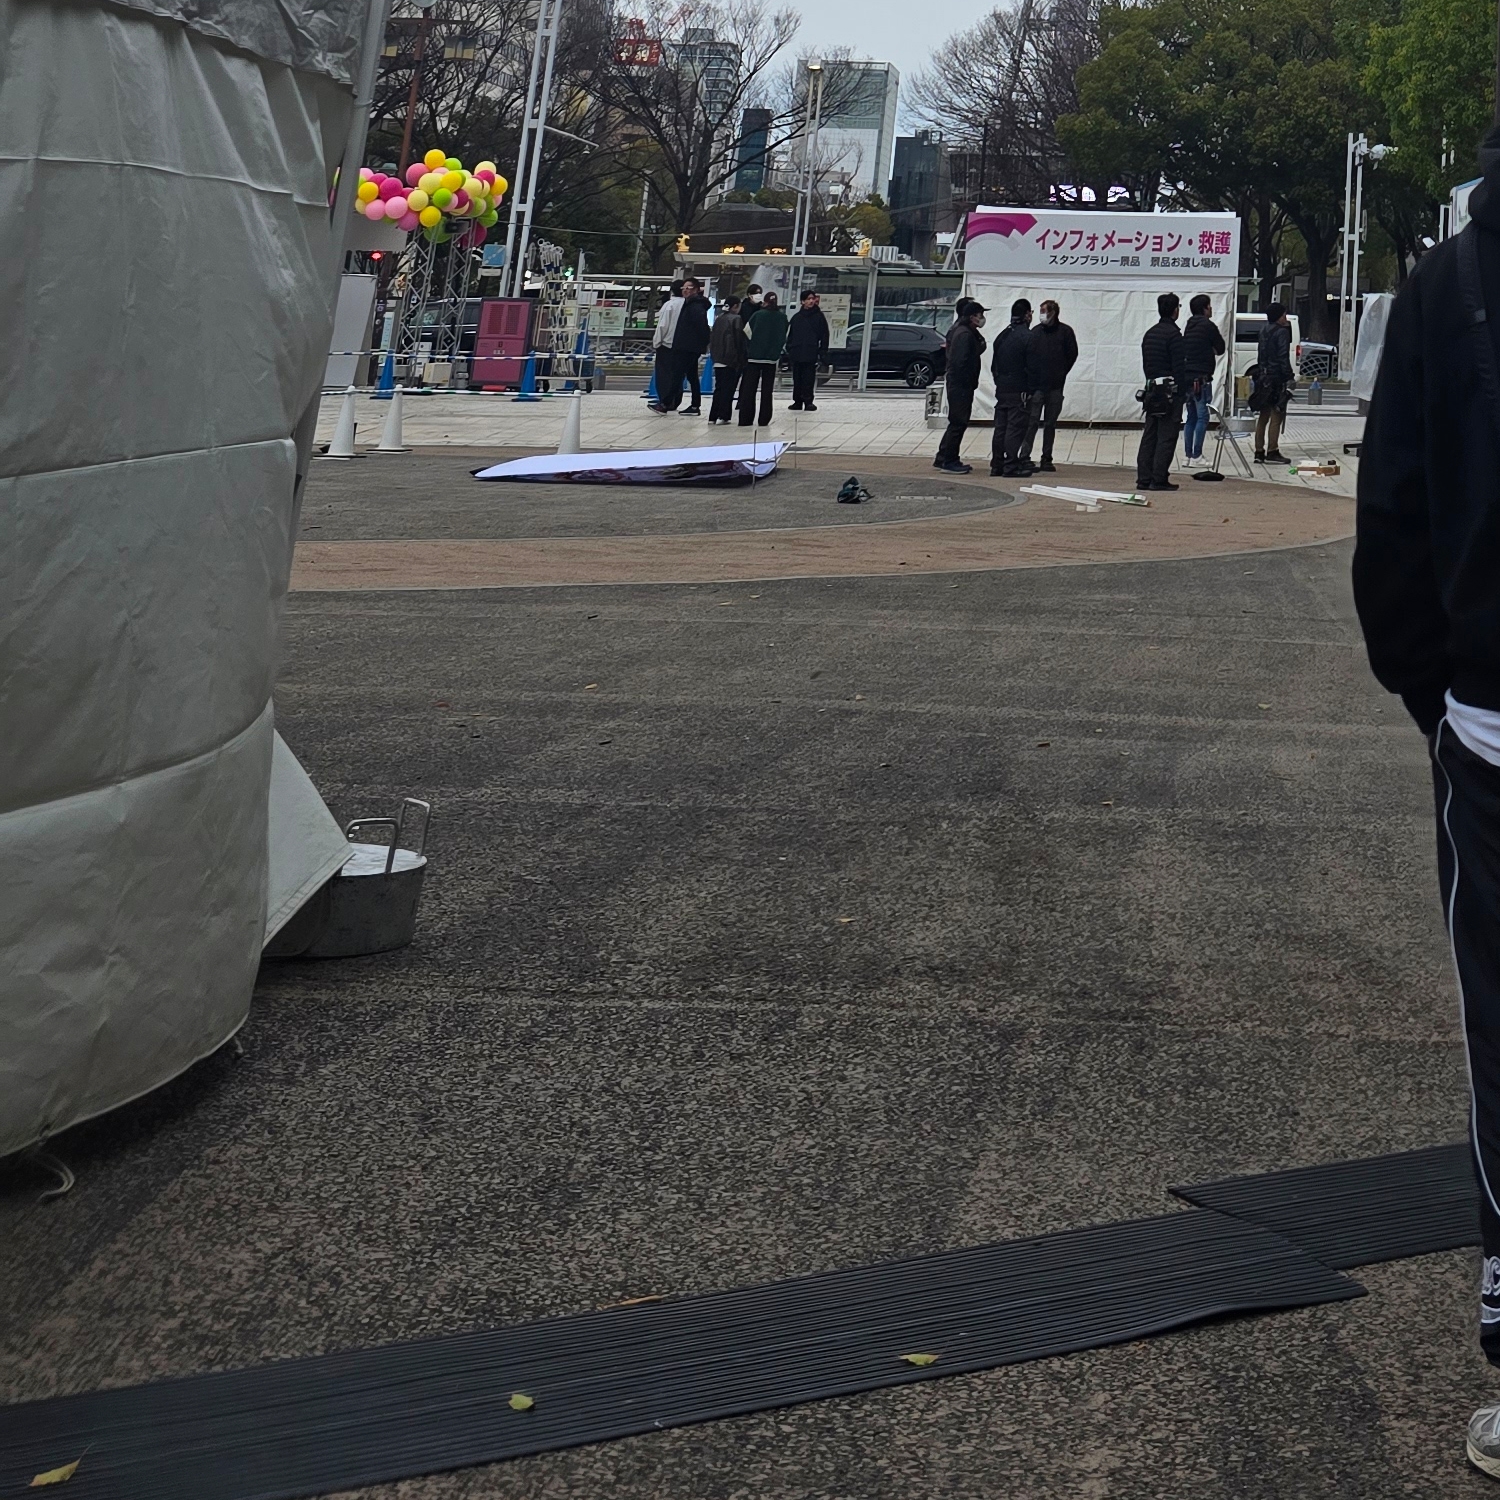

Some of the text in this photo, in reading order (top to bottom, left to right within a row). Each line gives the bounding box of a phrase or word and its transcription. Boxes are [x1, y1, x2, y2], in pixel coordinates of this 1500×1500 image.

[1036, 228, 1232, 255] インフォメーション・救護
[1049, 255, 1222, 268] スタンプラリー景品 景品お渡し場所
